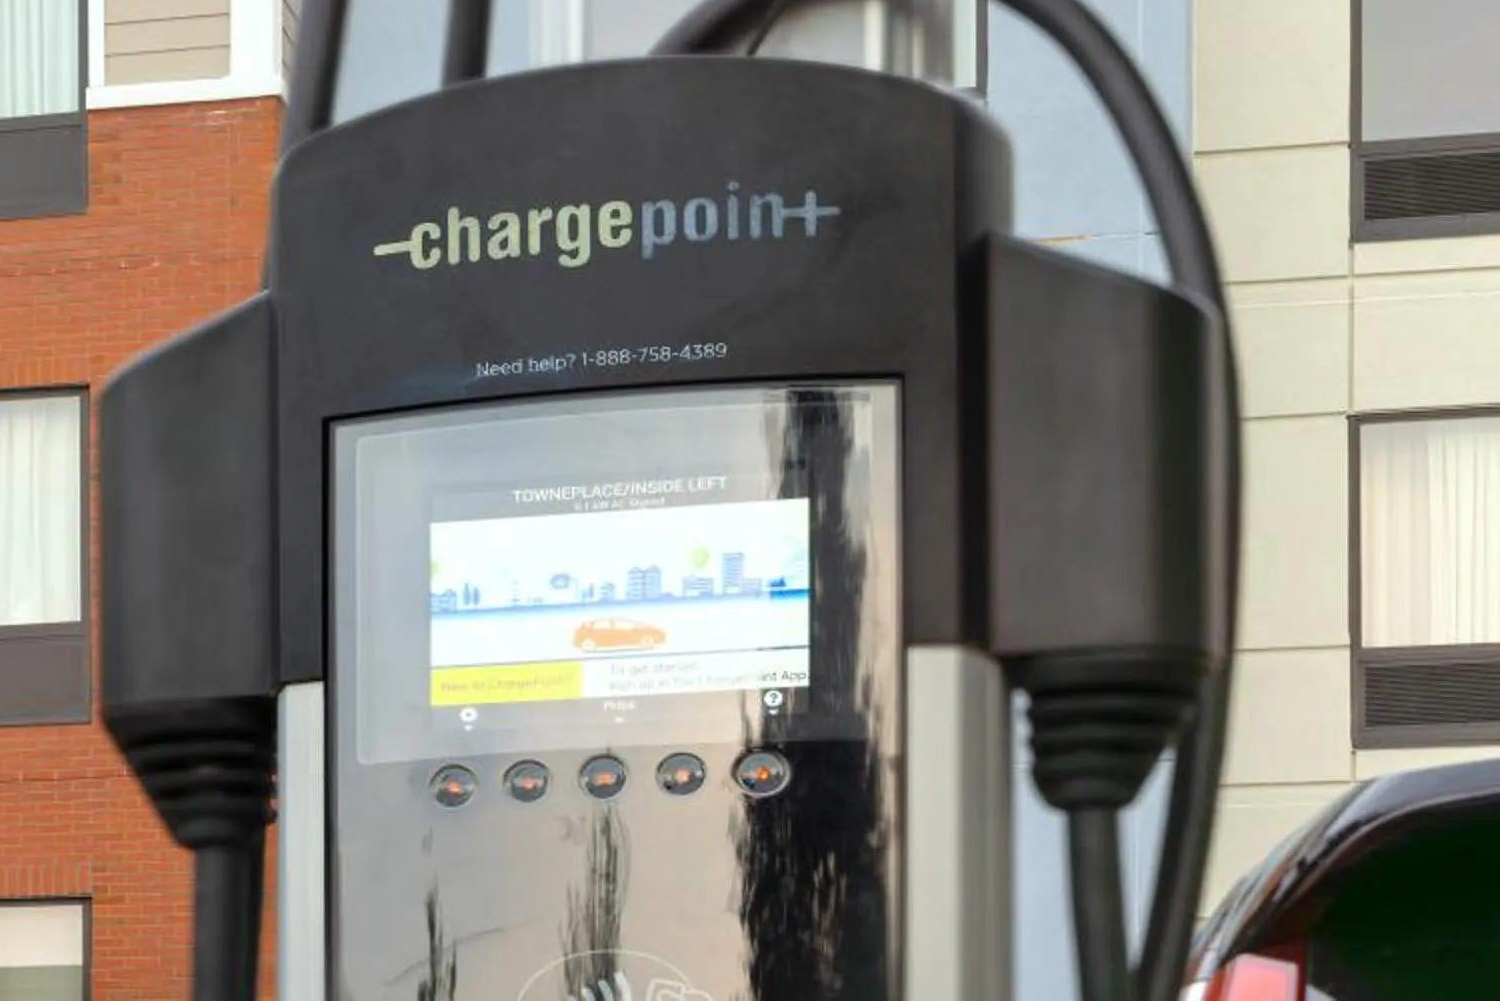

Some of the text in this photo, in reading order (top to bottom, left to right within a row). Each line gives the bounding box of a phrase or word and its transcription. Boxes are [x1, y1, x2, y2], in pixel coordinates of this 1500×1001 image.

[373, 181, 840, 269] chargepoint
[475, 342, 728, 377] Need help? 1-888-758-4389
[513, 478, 684, 504] TOWNEPLACE/INSIDE
[688, 475, 729, 490] LEFT
